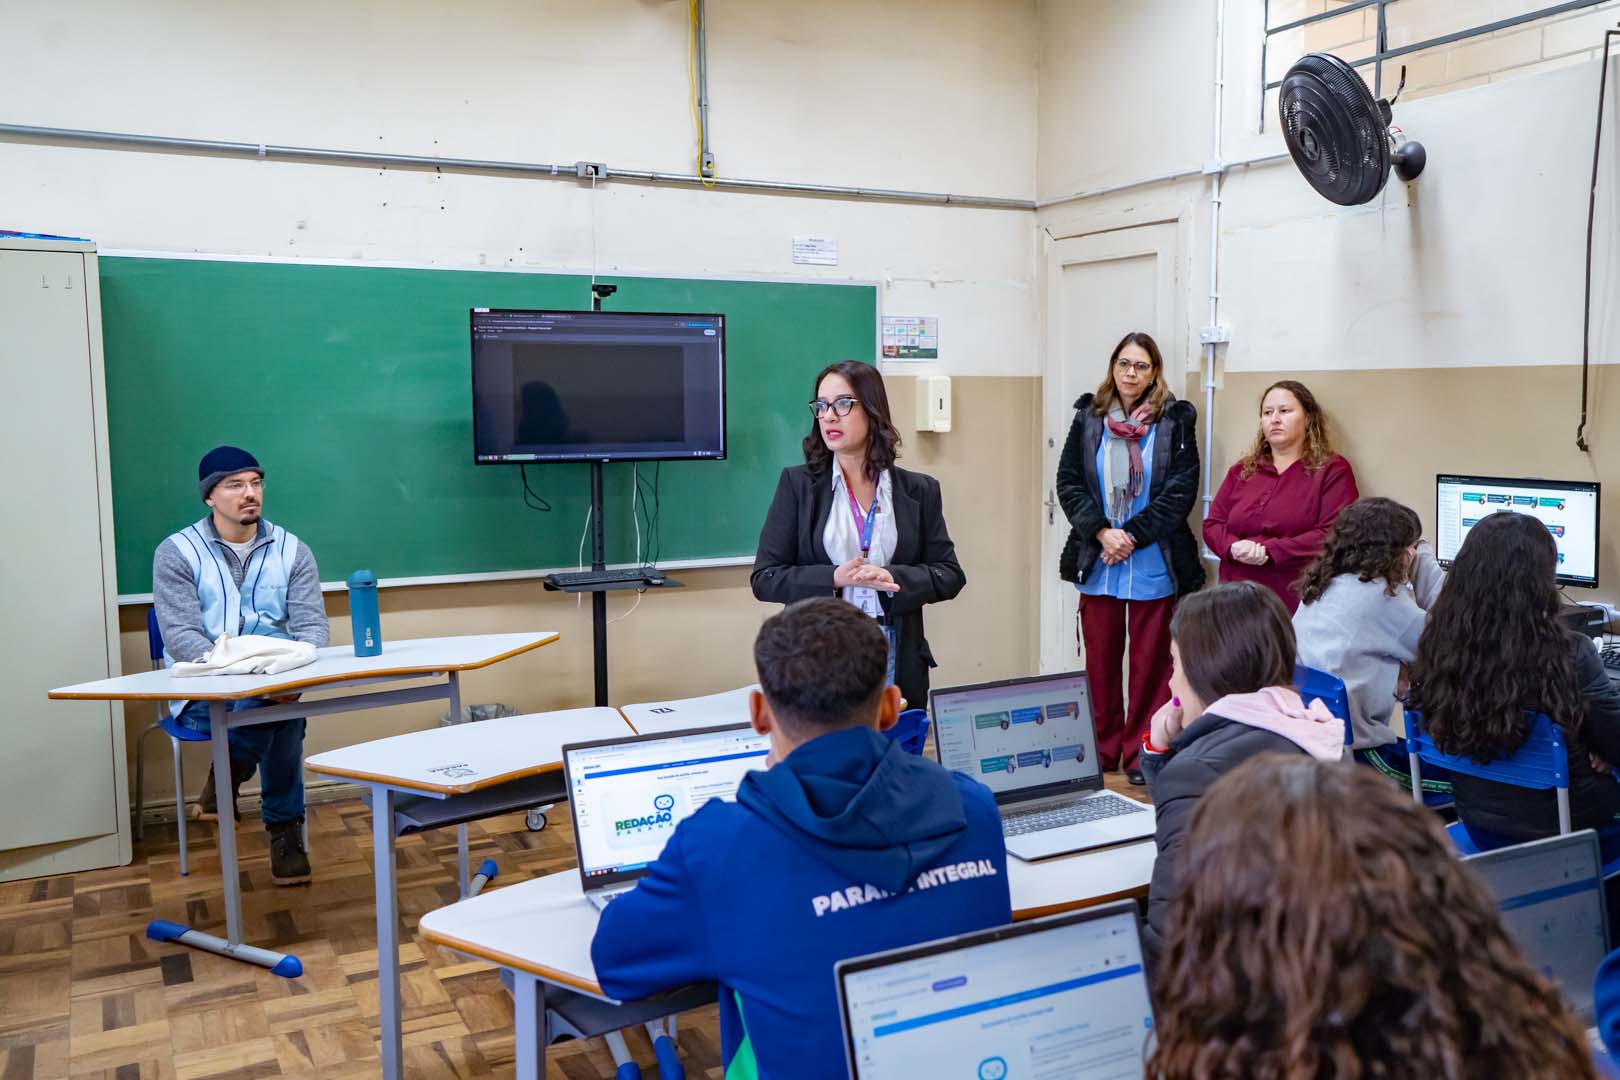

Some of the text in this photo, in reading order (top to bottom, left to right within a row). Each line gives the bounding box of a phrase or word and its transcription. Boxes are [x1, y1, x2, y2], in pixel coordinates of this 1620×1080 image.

[615, 811, 672, 830] REDAÇÃO
[812, 859, 998, 917] PARA INTEGRAL
